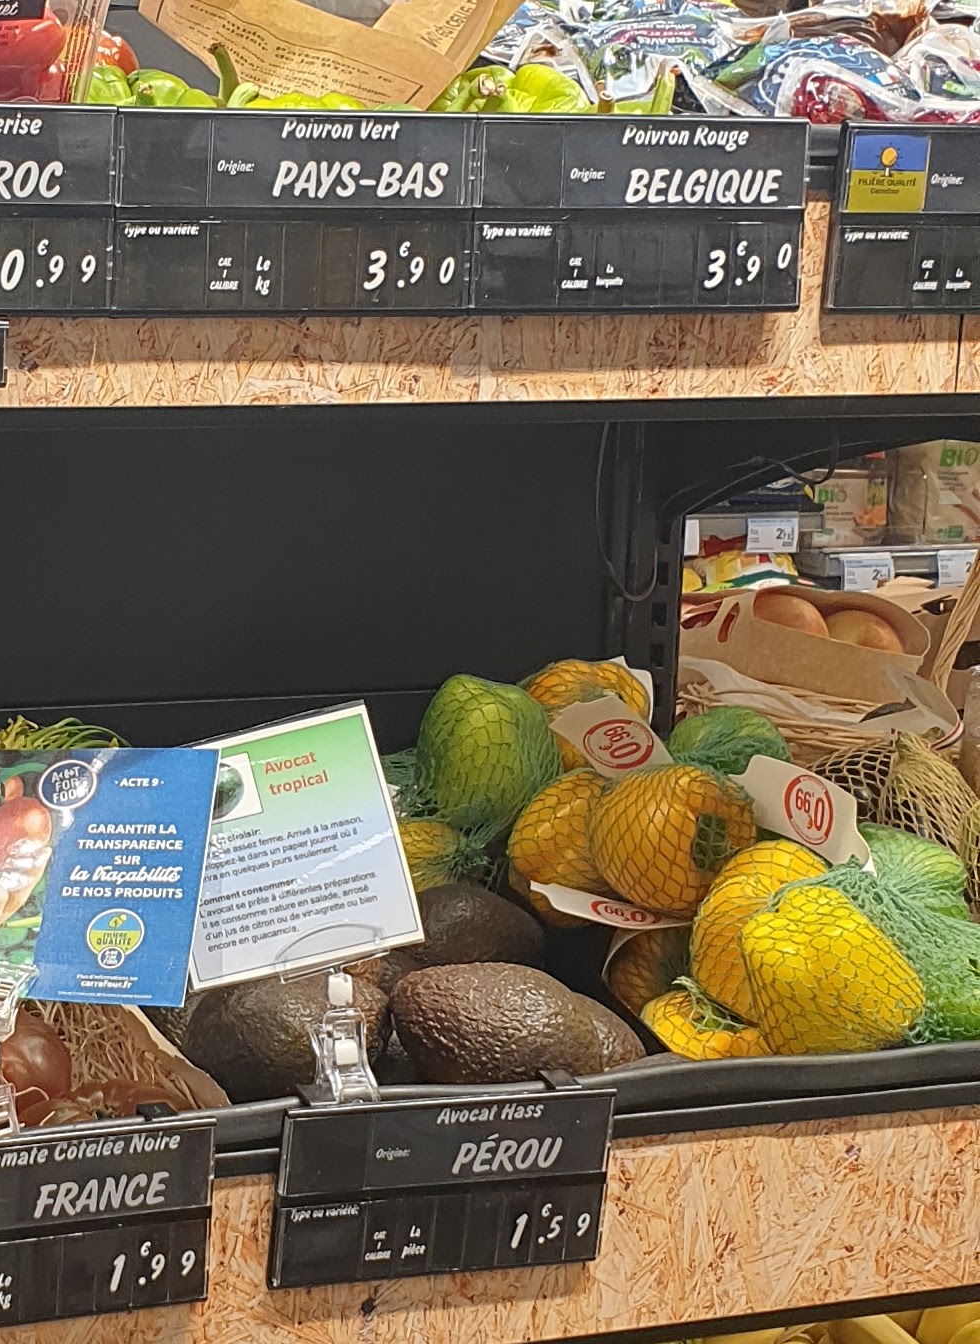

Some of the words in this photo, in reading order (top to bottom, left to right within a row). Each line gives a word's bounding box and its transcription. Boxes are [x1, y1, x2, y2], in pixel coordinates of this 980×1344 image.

[282, 119, 354, 140] Poivron
[359, 118, 400, 140] Vert
[622, 125, 689, 147] Poivron
[694, 125, 748, 152] Rouge
[218, 160, 254, 173] Origine:
[272, 160, 448, 198] PAYS-BAS
[570, 168, 605, 182] Origine:
[625, 167, 782, 205] BELGIQUE
[931, 173, 964, 187] Origine:
[124, 224, 146, 237] Type
[148, 225, 160, 235] ou
[256, 256, 271, 271] Le
[256, 278, 270, 295] kg
[265, 751, 316, 774] Avocat
[120, 778, 149, 787] ACTE
[152, 778, 159, 786] 9
[269, 770, 329, 795] tropical
[88, 824, 156, 834] GARANTIR
[159, 824, 177, 834] LA
[77, 840, 183, 850] TRANSPARENCE
[232, 840, 258, 853] assez
[259, 835, 285, 847] ferme.
[286, 827, 312, 840] Arrivé
[247, 848, 268, 861] dans
[269, 847, 281, 855] un
[282, 839, 308, 854] papier
[114, 856, 141, 865] SUR
[70, 865, 90, 881] la
[92, 865, 183, 885] traçabilité
[62, 886, 80, 897] DE
[83, 886, 112, 898] NOS
[114, 887, 183, 898] PRODUITS
[81, 980, 132, 988] carrefour.fr
[437, 1106, 498, 1124] Avocat
[501, 1104, 544, 1121] Hass
[129, 1132, 180, 1154] Noire
[452, 1133, 563, 1175] PÉROU
[34, 1171, 170, 1219] FRANCE
